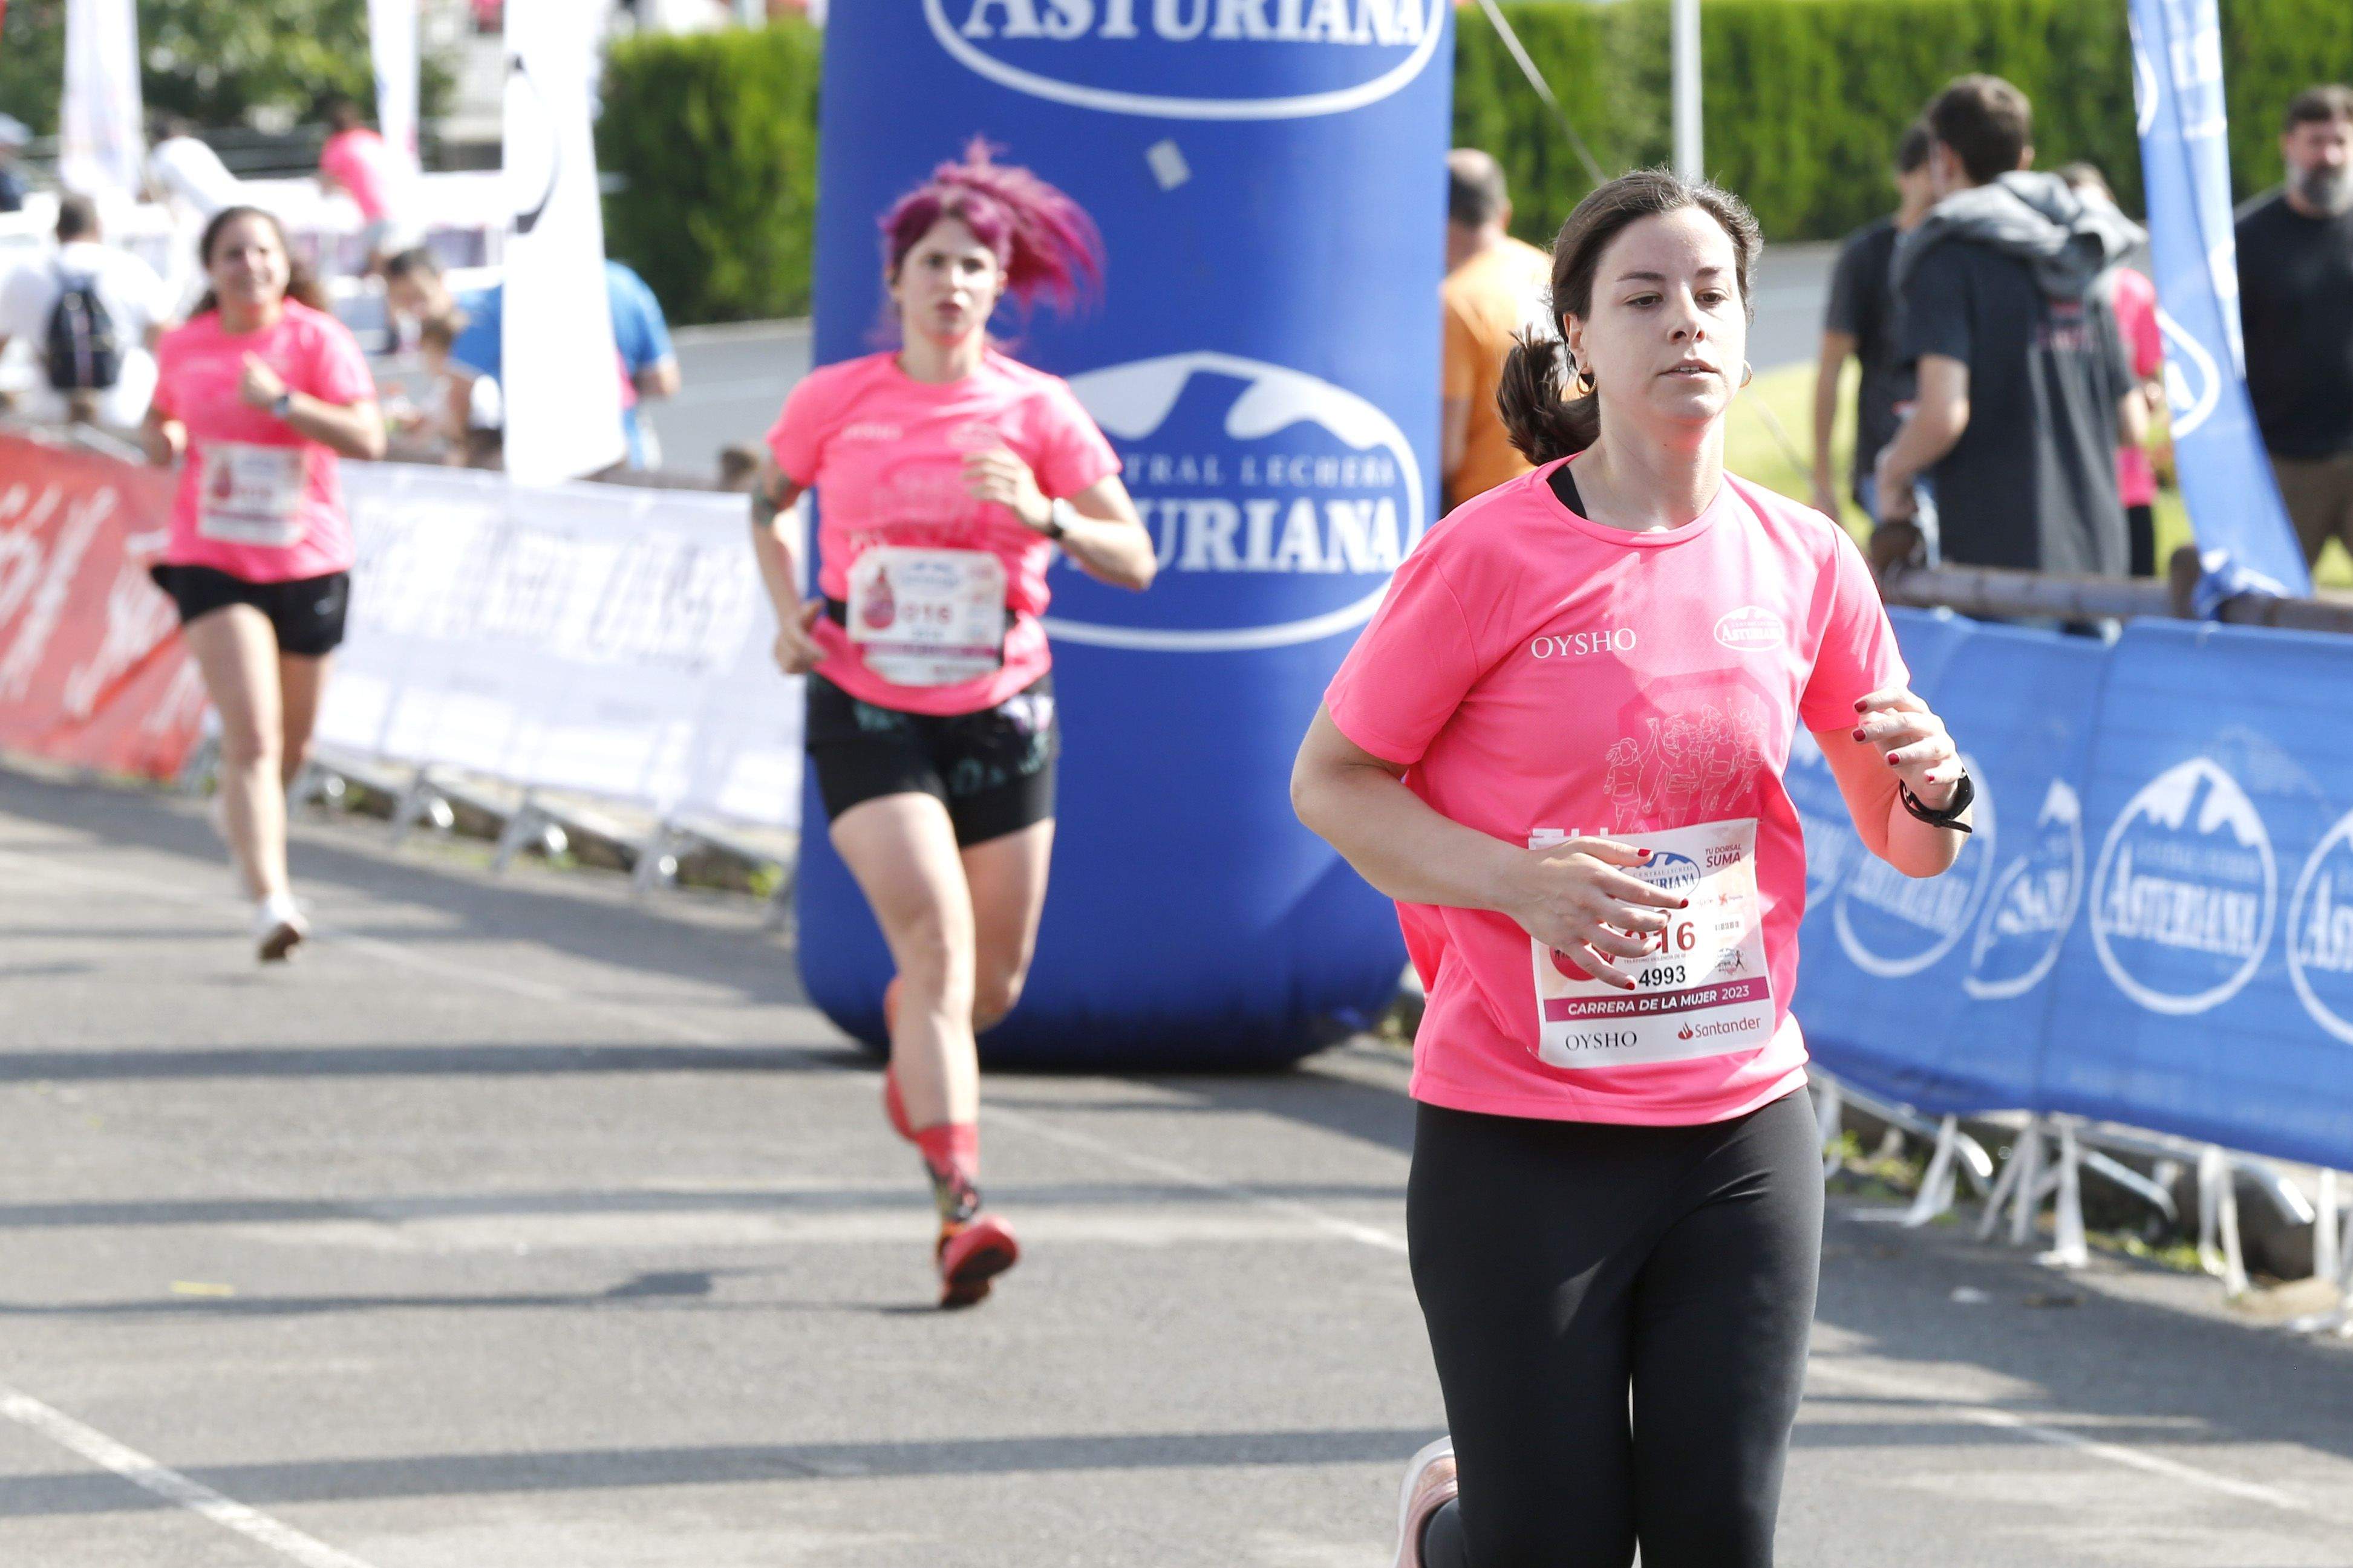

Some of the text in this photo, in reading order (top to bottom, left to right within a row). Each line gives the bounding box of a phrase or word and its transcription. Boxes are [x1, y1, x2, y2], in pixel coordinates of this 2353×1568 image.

[1125, 454, 1223, 484] TRAL
[1134, 495, 1402, 574] URIANA
[1530, 628, 1637, 659] OYSHO
[1715, 844, 1741, 853] DORSAL
[1706, 852, 1741, 868] SUMA
[1639, 965, 1686, 987] 4993
[1567, 984, 1749, 1016] CARRERA DE LA MUJER 2023
[1695, 1017, 1761, 1038] Santander
[1565, 1031, 1637, 1052] OYSHO
